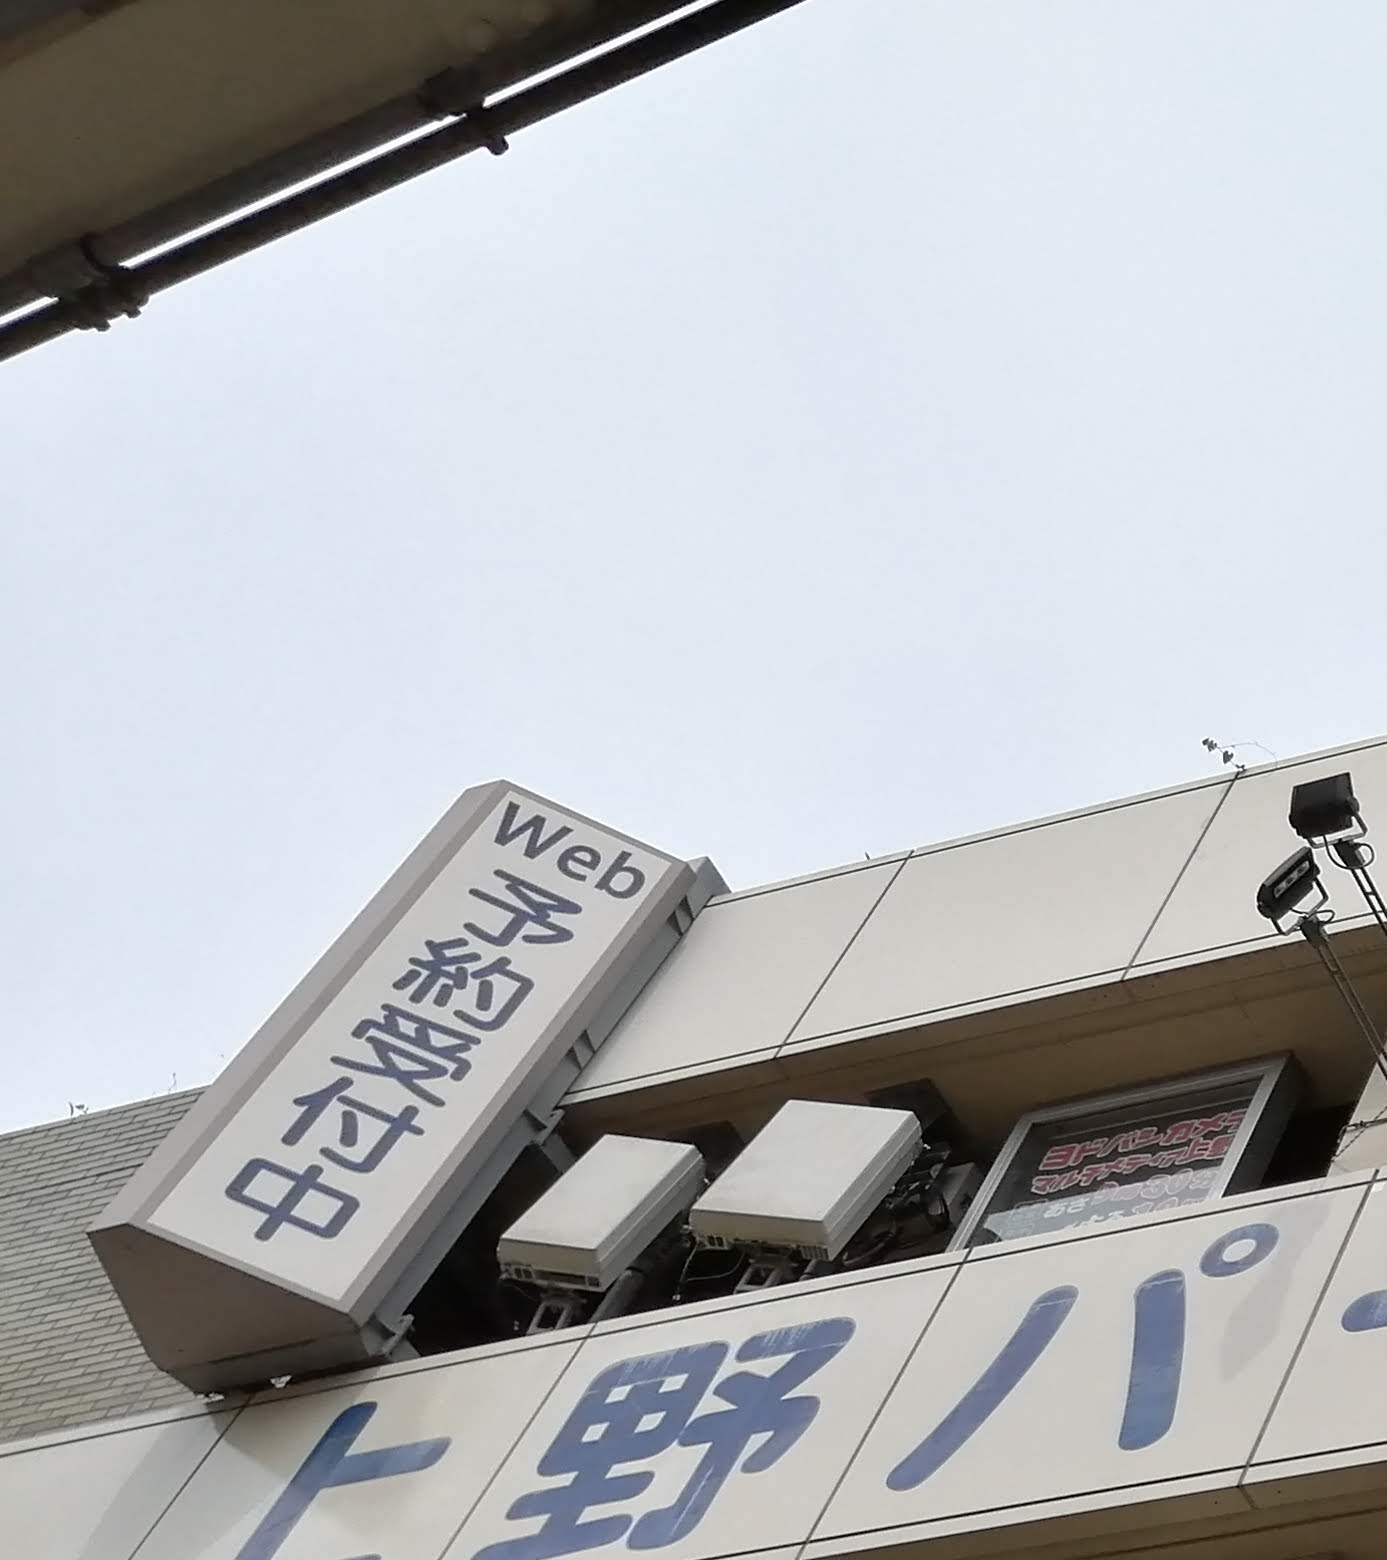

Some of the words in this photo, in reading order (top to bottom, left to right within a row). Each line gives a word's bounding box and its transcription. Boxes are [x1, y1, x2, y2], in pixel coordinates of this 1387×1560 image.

[493, 801, 646, 900] Web
[225, 868, 582, 1242] 予約受付中
